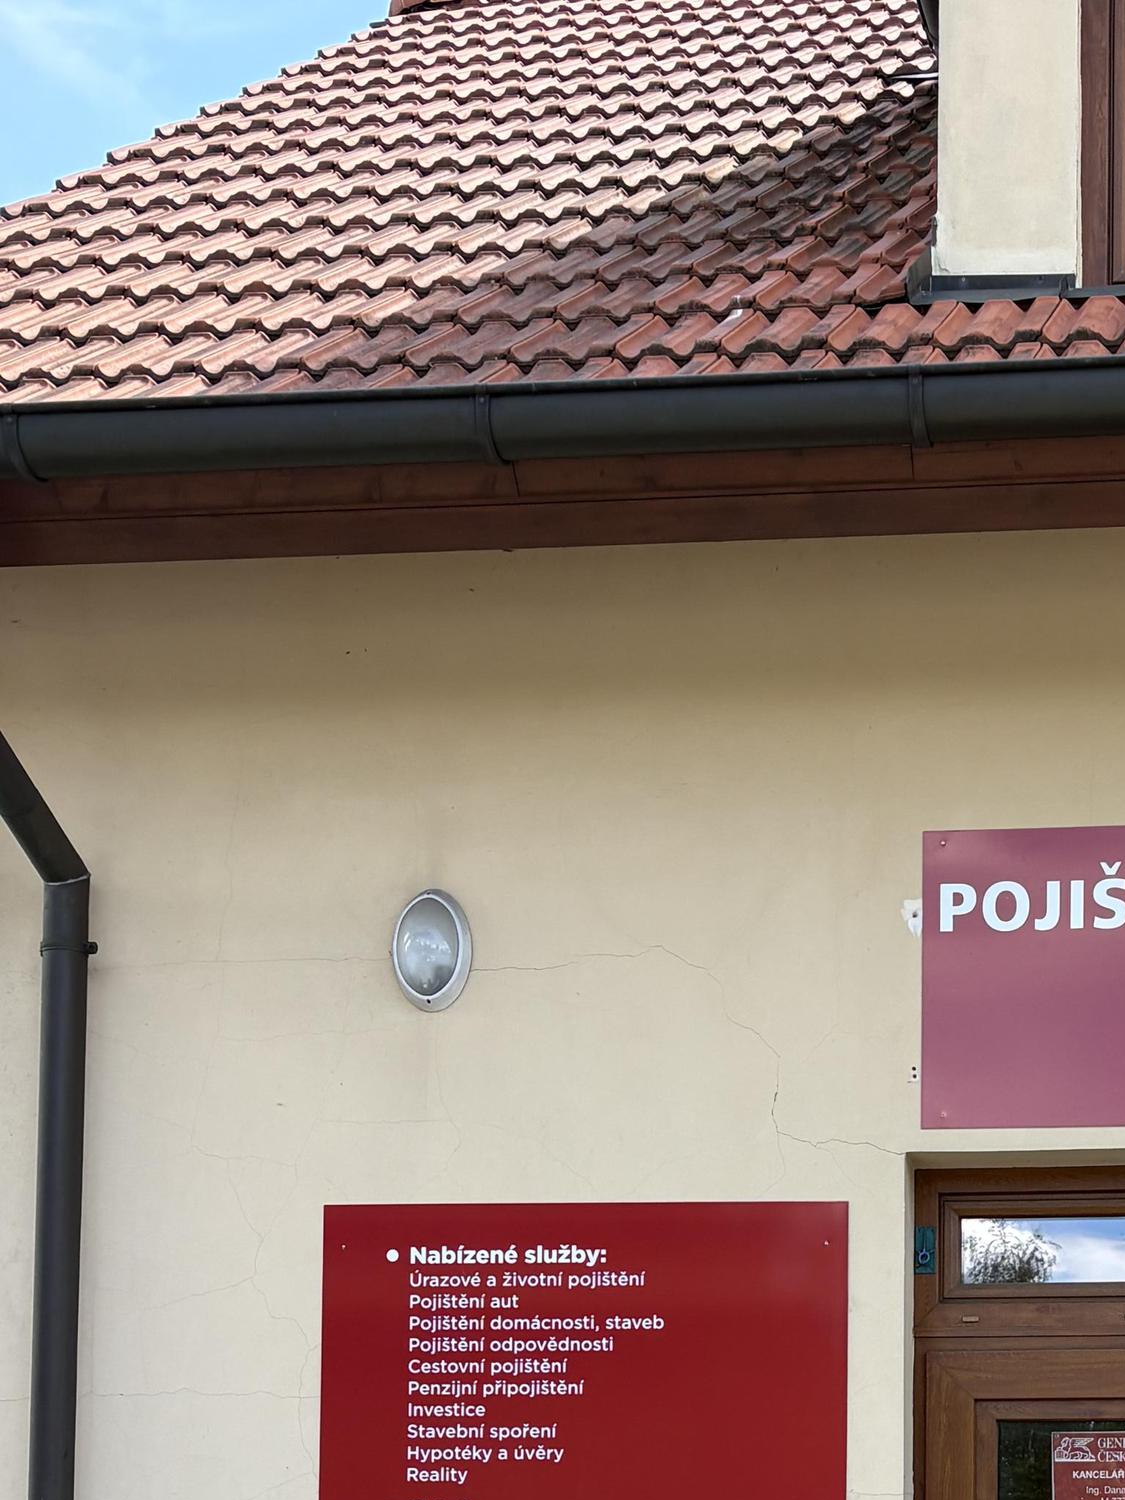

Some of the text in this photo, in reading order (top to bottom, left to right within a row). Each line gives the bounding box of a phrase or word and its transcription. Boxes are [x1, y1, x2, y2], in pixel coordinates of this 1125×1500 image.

[410, 1245, 606, 1266] Nabízené služby:
[410, 1270, 645, 1289] Úrazové a životní pojištění
[410, 1294, 519, 1311] Pojištění aut
[410, 1315, 664, 1332] Pojištění domácnosti, staveb
[409, 1337, 613, 1354] Pojištění odpovědnosti
[409, 1359, 567, 1376] Cestovní pojištění
[409, 1380, 584, 1397] Penzijní připojištění
[409, 1403, 485, 1416] Investice
[408, 1424, 557, 1441] Stavební spoření
[408, 1445, 563, 1462] Hypotéky a úvěry
[407, 1467, 467, 1484] Reality
[1072, 1468, 1125, 1479] KANCELÁŘ
[1086, 1486, 1101, 1496] Ing.
[1104, 1486, 1125, 1494] Dana
